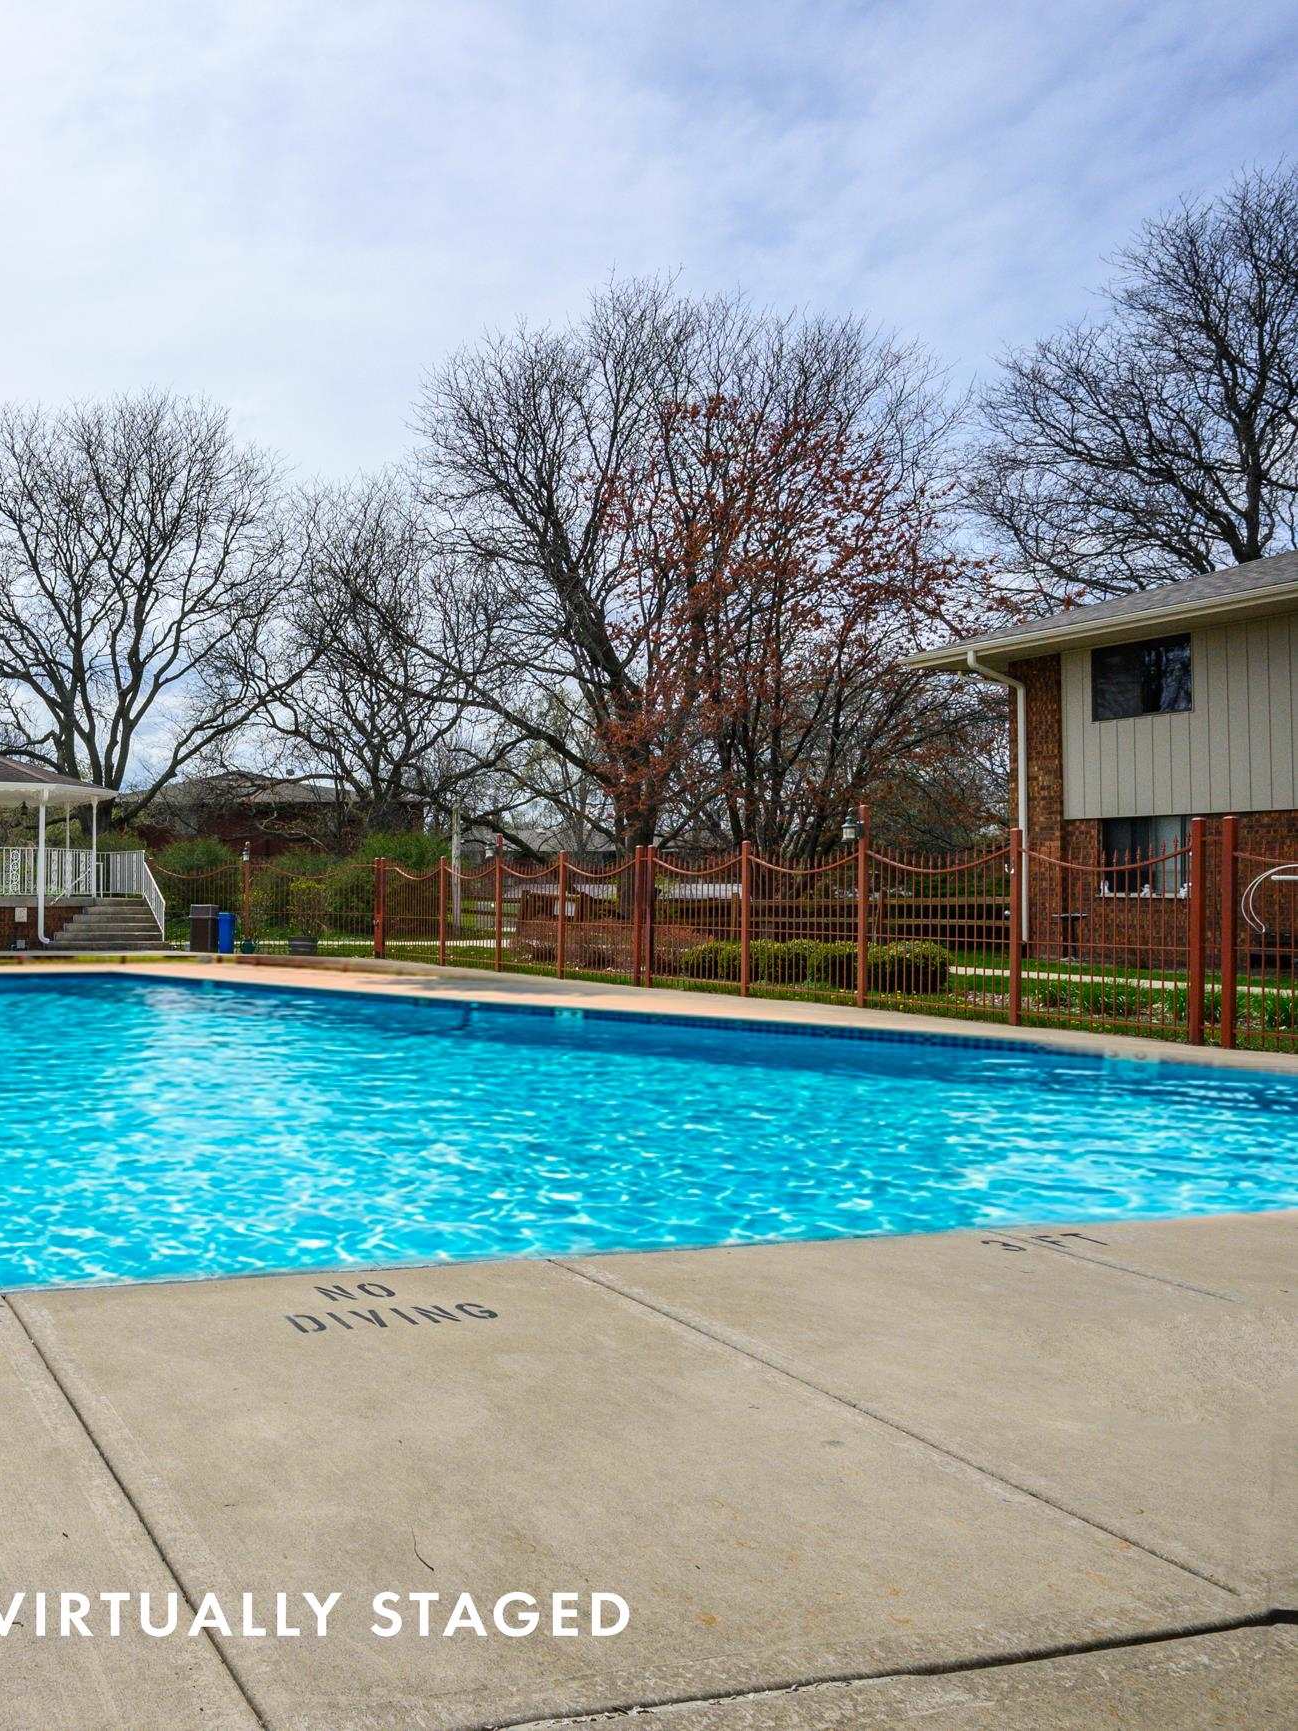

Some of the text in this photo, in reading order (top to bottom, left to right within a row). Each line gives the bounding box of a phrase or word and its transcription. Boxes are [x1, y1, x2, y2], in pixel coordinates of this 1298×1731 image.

[1030, 1232, 1109, 1248] FT
[313, 1283, 396, 1301] NO
[284, 1303, 498, 1333] DIVING
